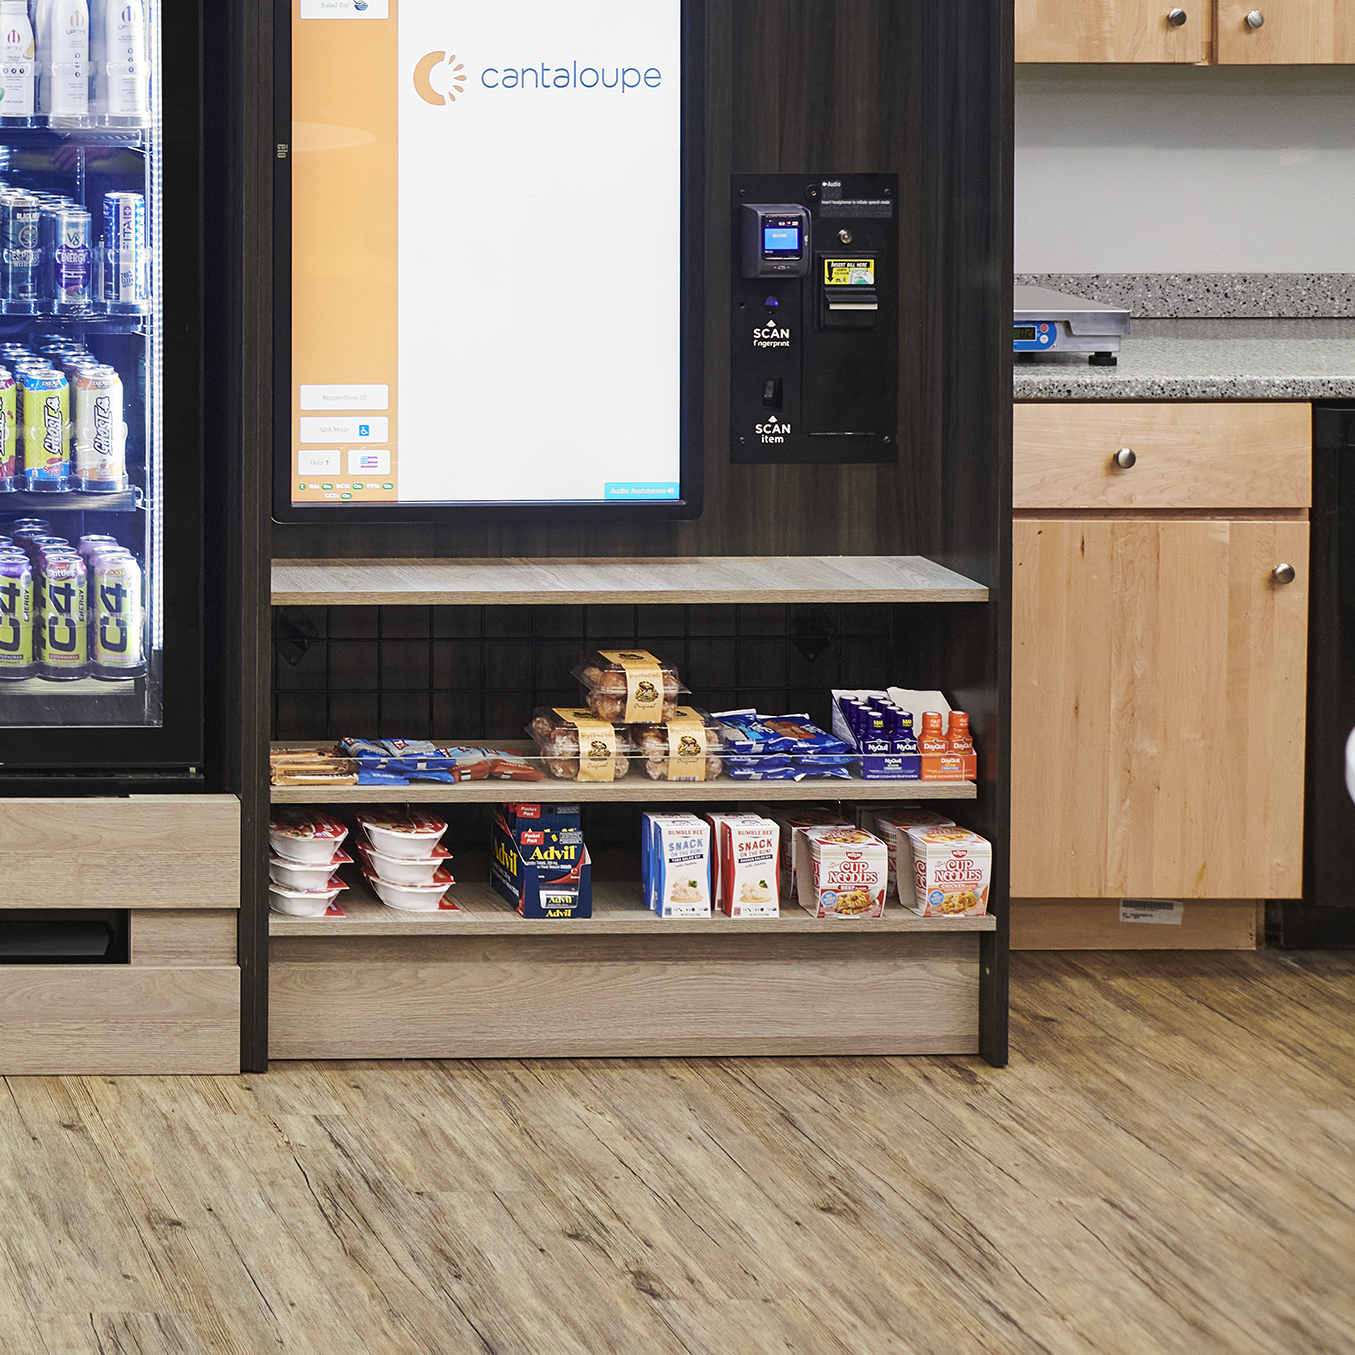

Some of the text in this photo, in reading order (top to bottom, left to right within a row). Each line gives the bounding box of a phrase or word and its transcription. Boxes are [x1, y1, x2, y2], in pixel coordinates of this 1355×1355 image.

[481, 60, 661, 93] cantaloupe
[67, 232, 82, 248] V8
[61, 254, 85, 264] ENERGY
[753, 329, 790, 339] SCAN
[753, 339, 790, 348] fingerprint
[322, 394, 358, 402] Suggestions
[44, 406, 63, 455] GHOST
[94, 406, 113, 455] GHOST
[755, 424, 791, 434] SCAN
[761, 434, 784, 444] item
[309, 459, 324, 467] Help
[610, 487, 666, 495] Audio Assistance
[49, 583, 77, 652] C4
[633, 702, 656, 710] Original
[924, 743, 945, 751] DayQuil
[668, 839, 703, 852] SNACK
[738, 839, 773, 852] SNACK
[494, 837, 517, 876] Advil
[529, 846, 576, 860] Advil
[840, 861, 869, 872] CUP
[946, 859, 973, 870] CUP
[828, 870, 878, 884] NOODLES
[934, 869, 982, 882] NOODLES
[549, 896, 572, 904] Advil
